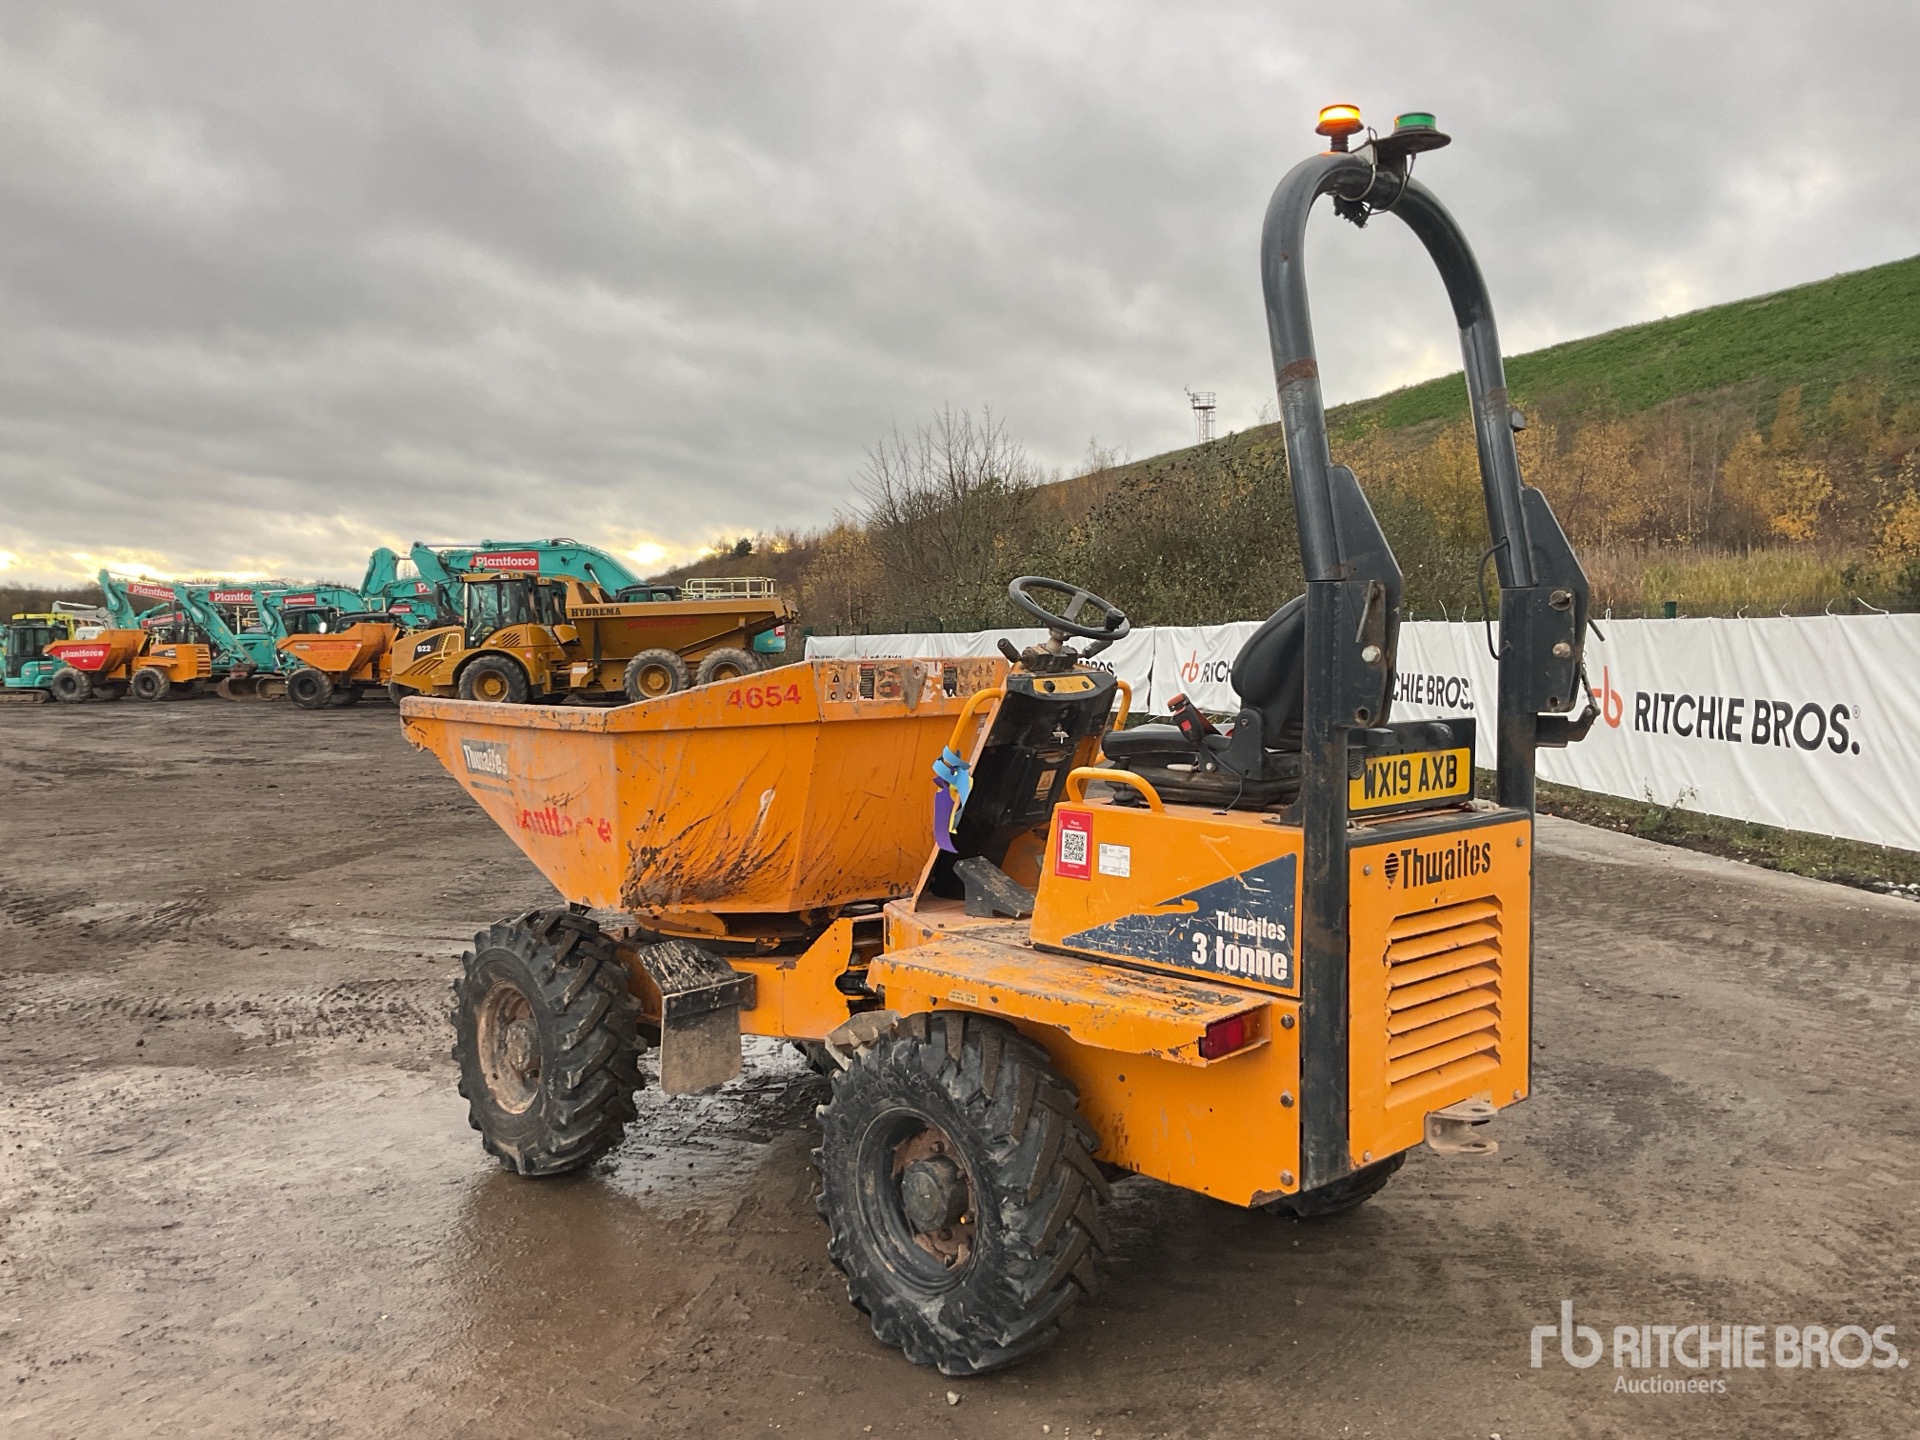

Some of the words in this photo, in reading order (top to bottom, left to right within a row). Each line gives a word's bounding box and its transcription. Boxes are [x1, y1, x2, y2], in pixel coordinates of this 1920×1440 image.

[475, 556, 537, 568] Plantforce
[214, 592, 253, 602] Plantfo
[571, 607, 621, 618] HYDREMA
[60, 649, 104, 660] plantforce
[1200, 661, 1232, 683] RITCH
[727, 683, 801, 710] 4654
[1634, 691, 1745, 743] RITCHIE
[1751, 699, 1861, 755] BROS.
[1363, 759, 1412, 800] WX19
[1418, 754, 1458, 793] AXB
[1401, 839, 1491, 889] Thwaites
[1216, 911, 1286, 942] Thwaites
[1192, 932, 1208, 964] 3
[1215, 938, 1288, 980] tonne
